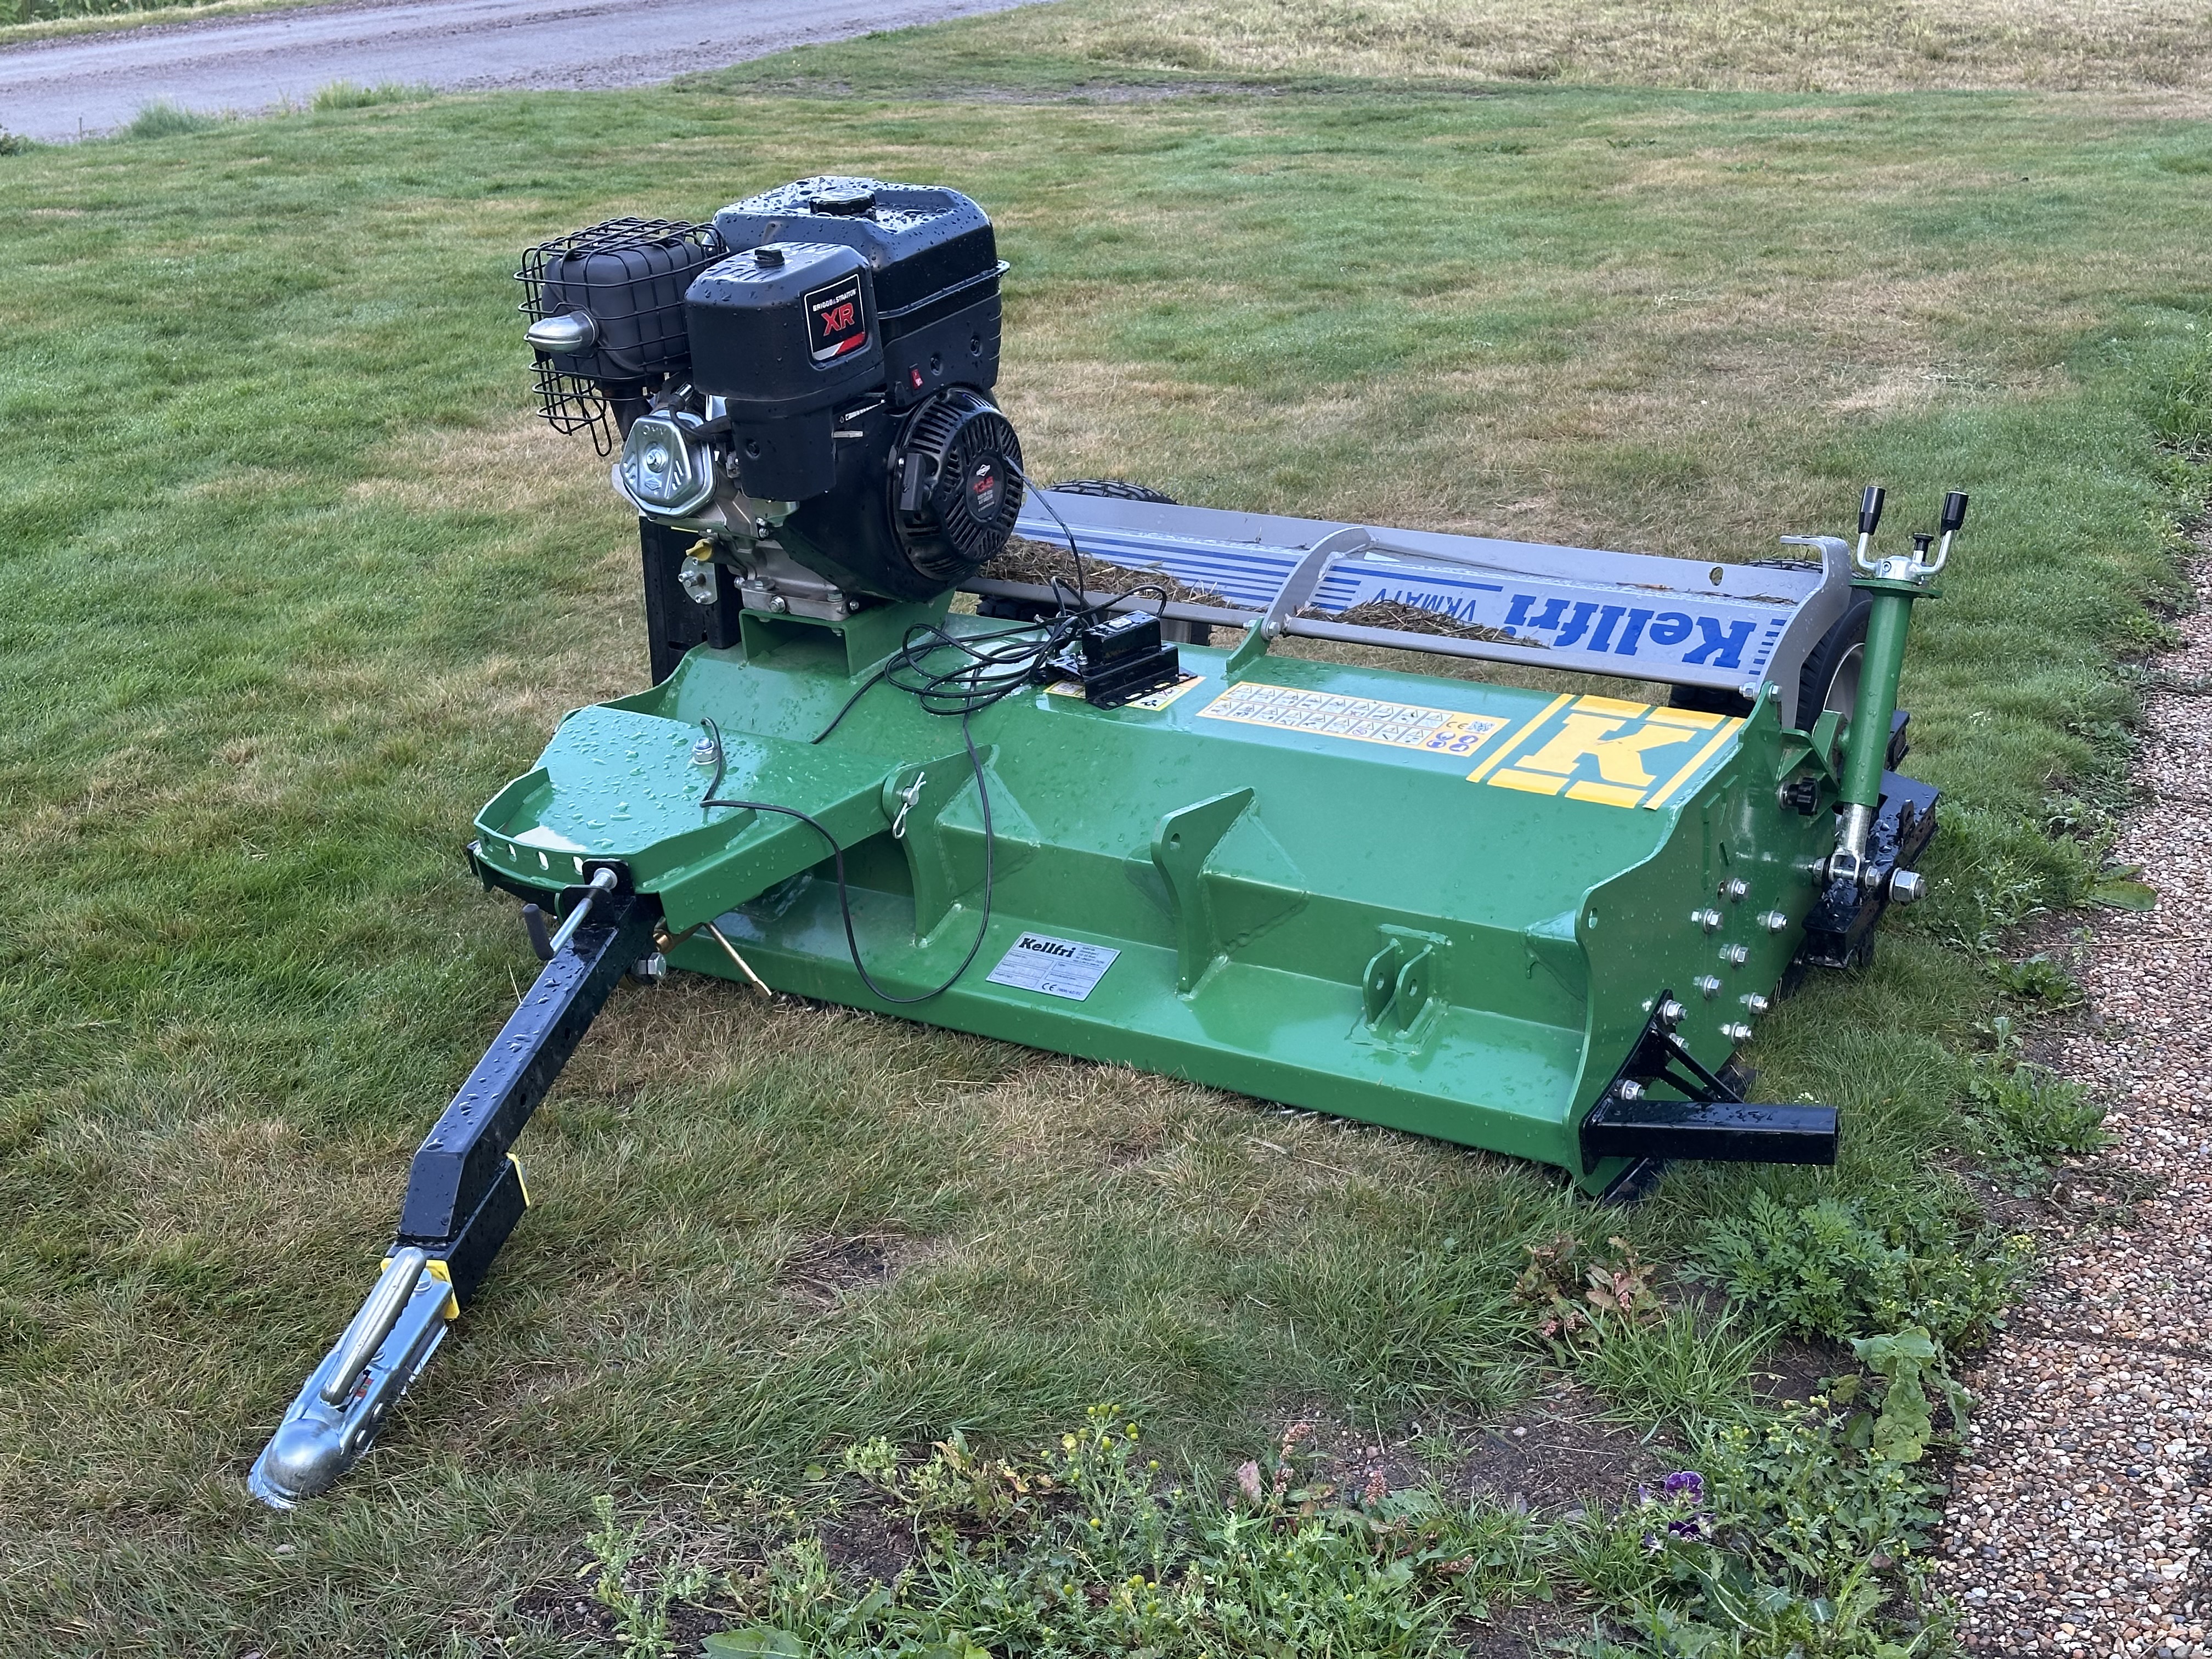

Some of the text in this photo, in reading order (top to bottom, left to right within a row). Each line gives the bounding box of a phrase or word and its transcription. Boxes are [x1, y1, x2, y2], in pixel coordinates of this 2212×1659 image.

[821, 302, 855, 337] XR
[1504, 594, 1757, 669] Kellfri
[1514, 713, 1697, 787] K
[1018, 937, 1076, 958] Kellfri
